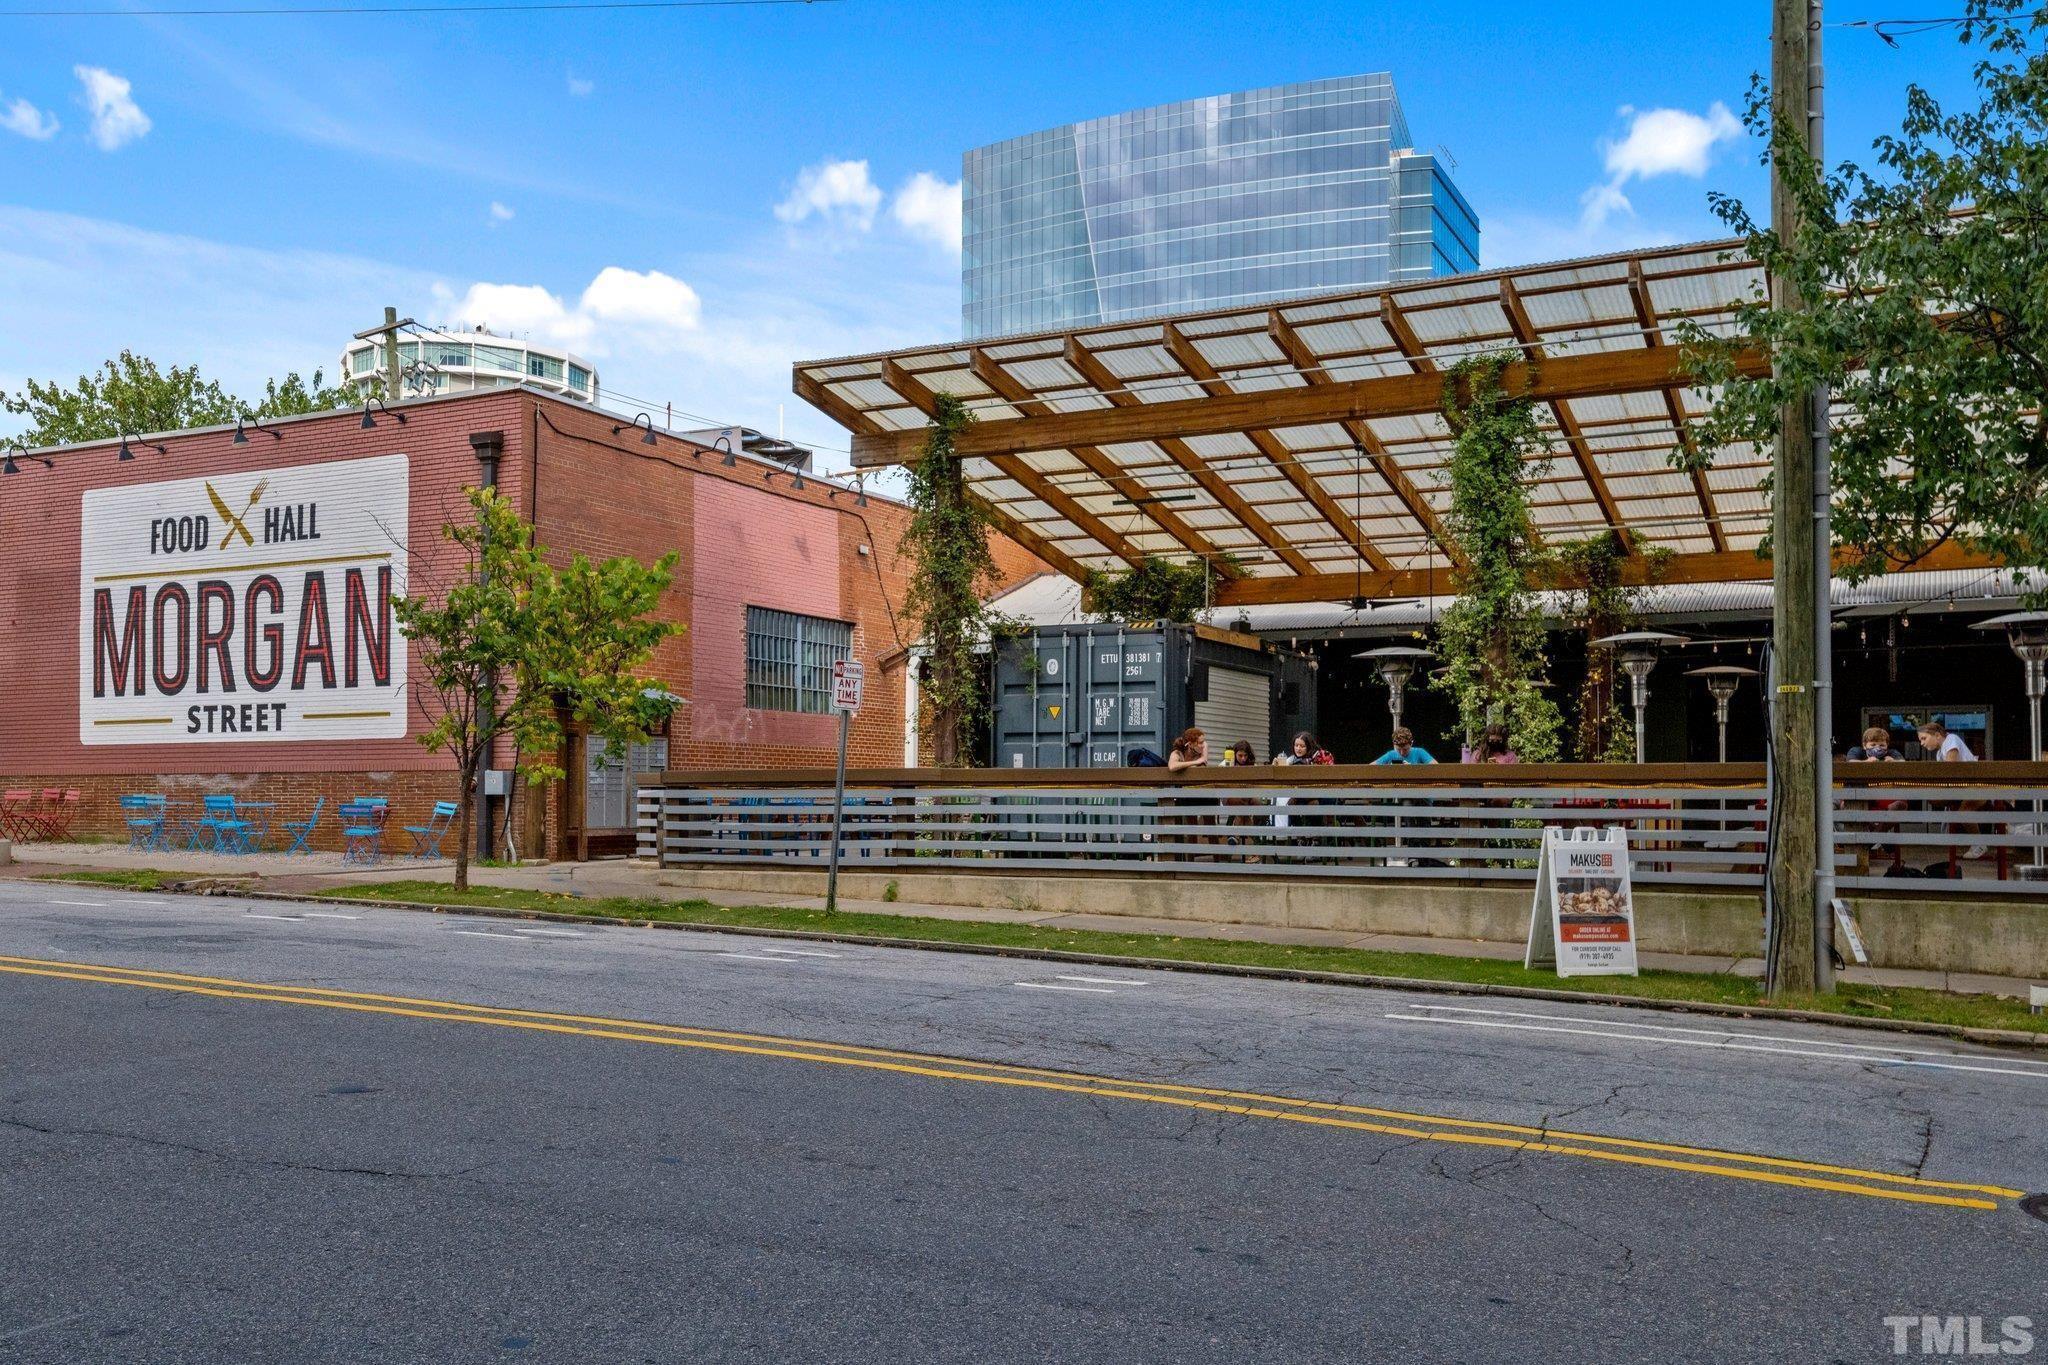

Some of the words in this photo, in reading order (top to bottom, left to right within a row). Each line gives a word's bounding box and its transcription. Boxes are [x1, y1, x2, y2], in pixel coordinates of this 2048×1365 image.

[150, 515, 209, 554] FOOD
[264, 503, 321, 543] HALL
[93, 565, 391, 698] MORGAN
[1101, 654, 1118, 664] ETTU
[1125, 653, 1150, 663] 381381
[835, 664, 844, 674] NO
[844, 666, 862, 674] PARKING
[1126, 666, 1142, 676] 25G1
[839, 679, 857, 688] ANY
[837, 689, 858, 700] TIME
[1096, 707, 1110, 717] TARE
[187, 703, 286, 734] STREET
[1095, 717, 1107, 726] NET
[1570, 854, 1601, 867] MAKUS
